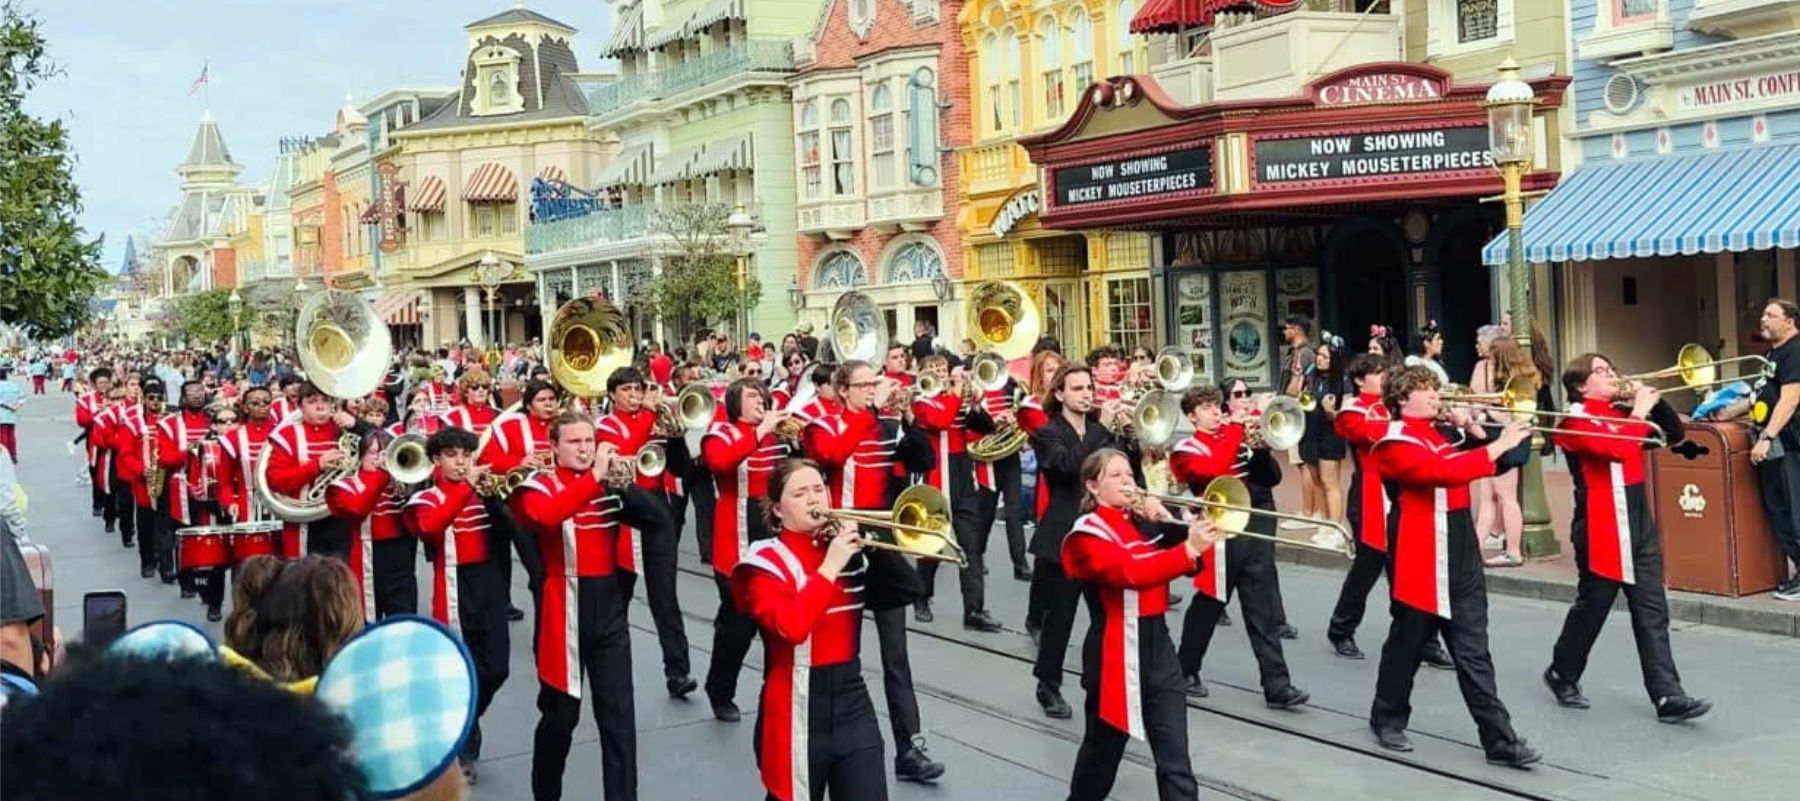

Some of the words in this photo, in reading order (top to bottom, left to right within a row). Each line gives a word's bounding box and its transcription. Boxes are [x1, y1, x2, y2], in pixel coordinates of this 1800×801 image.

[1319, 79, 1437, 104] CINEMA
[1349, 74, 1388, 87] MAIN
[1695, 82, 1731, 105] MAIN
[1735, 80, 1754, 100] ST.
[1311, 138, 1351, 155] NOW
[1363, 131, 1445, 152] SHOWING
[1091, 164, 1114, 181] NOW
[1120, 156, 1168, 176] SHOWING
[1266, 161, 1330, 181] MICKEY
[1342, 150, 1492, 175] MOUSETERPIECES
[1068, 186, 1102, 203] MICKEY
[1108, 173, 1196, 198] MOUSETERPIECES
